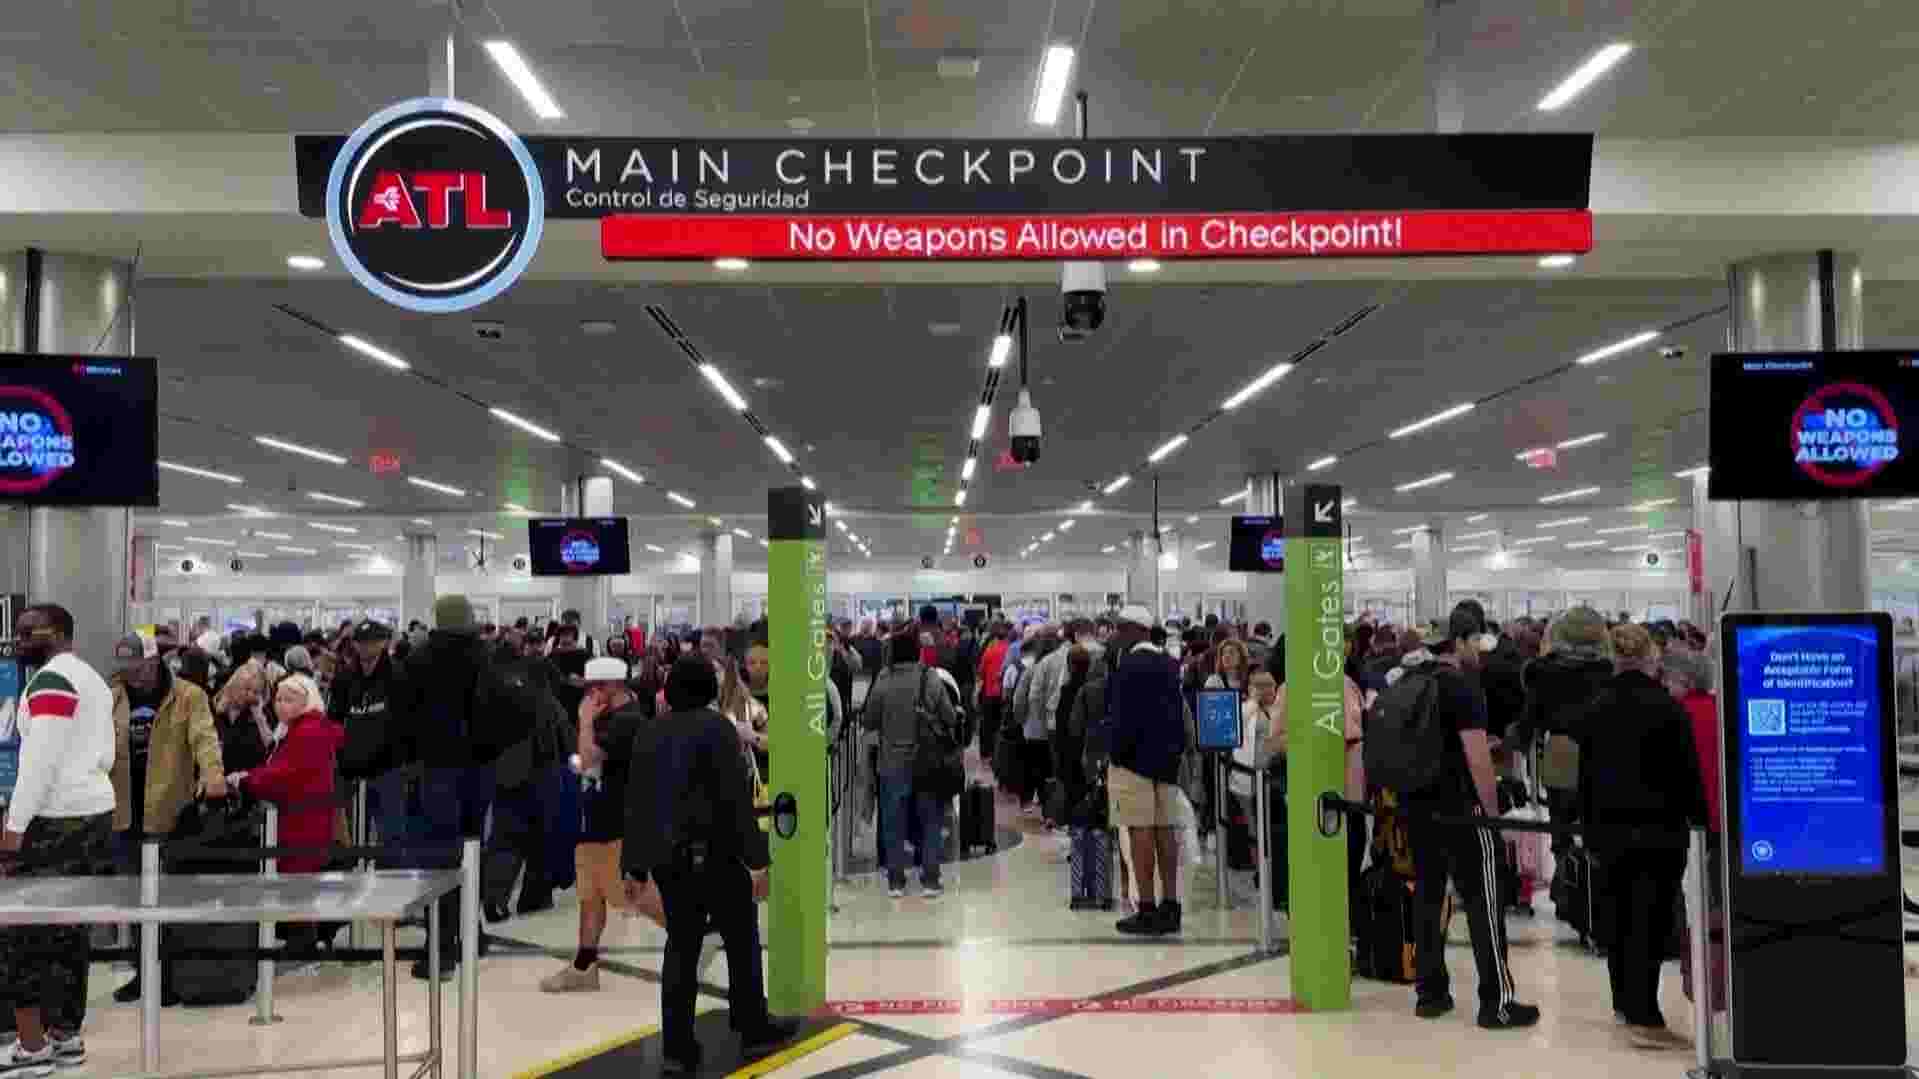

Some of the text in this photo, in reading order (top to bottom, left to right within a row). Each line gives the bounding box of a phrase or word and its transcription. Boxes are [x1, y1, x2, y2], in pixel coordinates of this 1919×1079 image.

[566, 147, 1207, 185] MAIN CHECKPOINT
[357, 169, 512, 230] ATL
[566, 187, 809, 212] Control de Seguridad
[788, 220, 836, 252] No
[845, 219, 1007, 257] Weapons
[1016, 219, 1148, 251] Allowed
[1200, 215, 1403, 255] Checkpoint!
[1825, 407, 1868, 428] NO
[0, 434, 74, 451] APONS
[1797, 430, 1899, 445] WEAPONS
[0, 451, 75, 469] LOWED
[1795, 446, 1900, 463] ALLOWED
[806, 582, 827, 736] All Gates
[1310, 582, 1342, 737] All Gates
